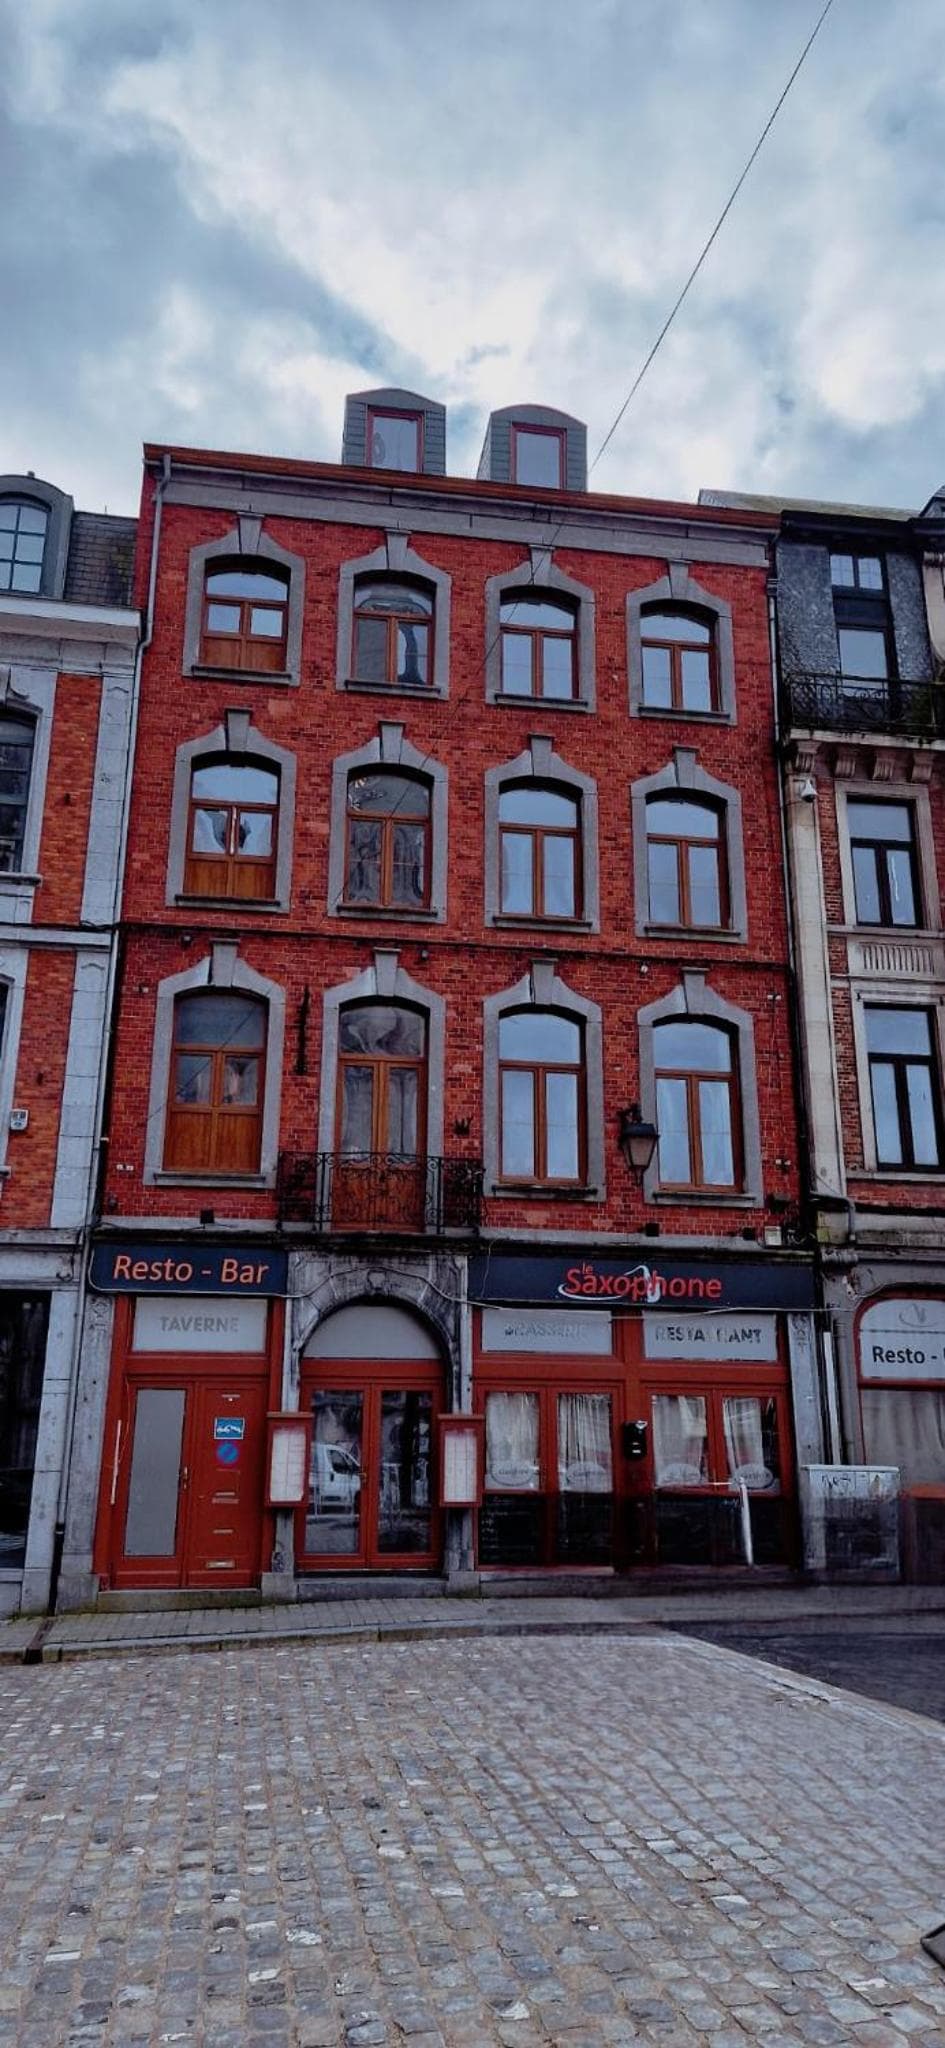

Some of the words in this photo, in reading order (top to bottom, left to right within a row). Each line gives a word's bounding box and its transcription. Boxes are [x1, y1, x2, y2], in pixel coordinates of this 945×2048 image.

[113, 1254, 193, 1282] Resto
[220, 1258, 270, 1284] Bar
[581, 1262, 594, 1274] le
[565, 1268, 723, 1302] Saxophone
[160, 1316, 239, 1333] TAVERNE
[872, 1345, 925, 1364] Resto
